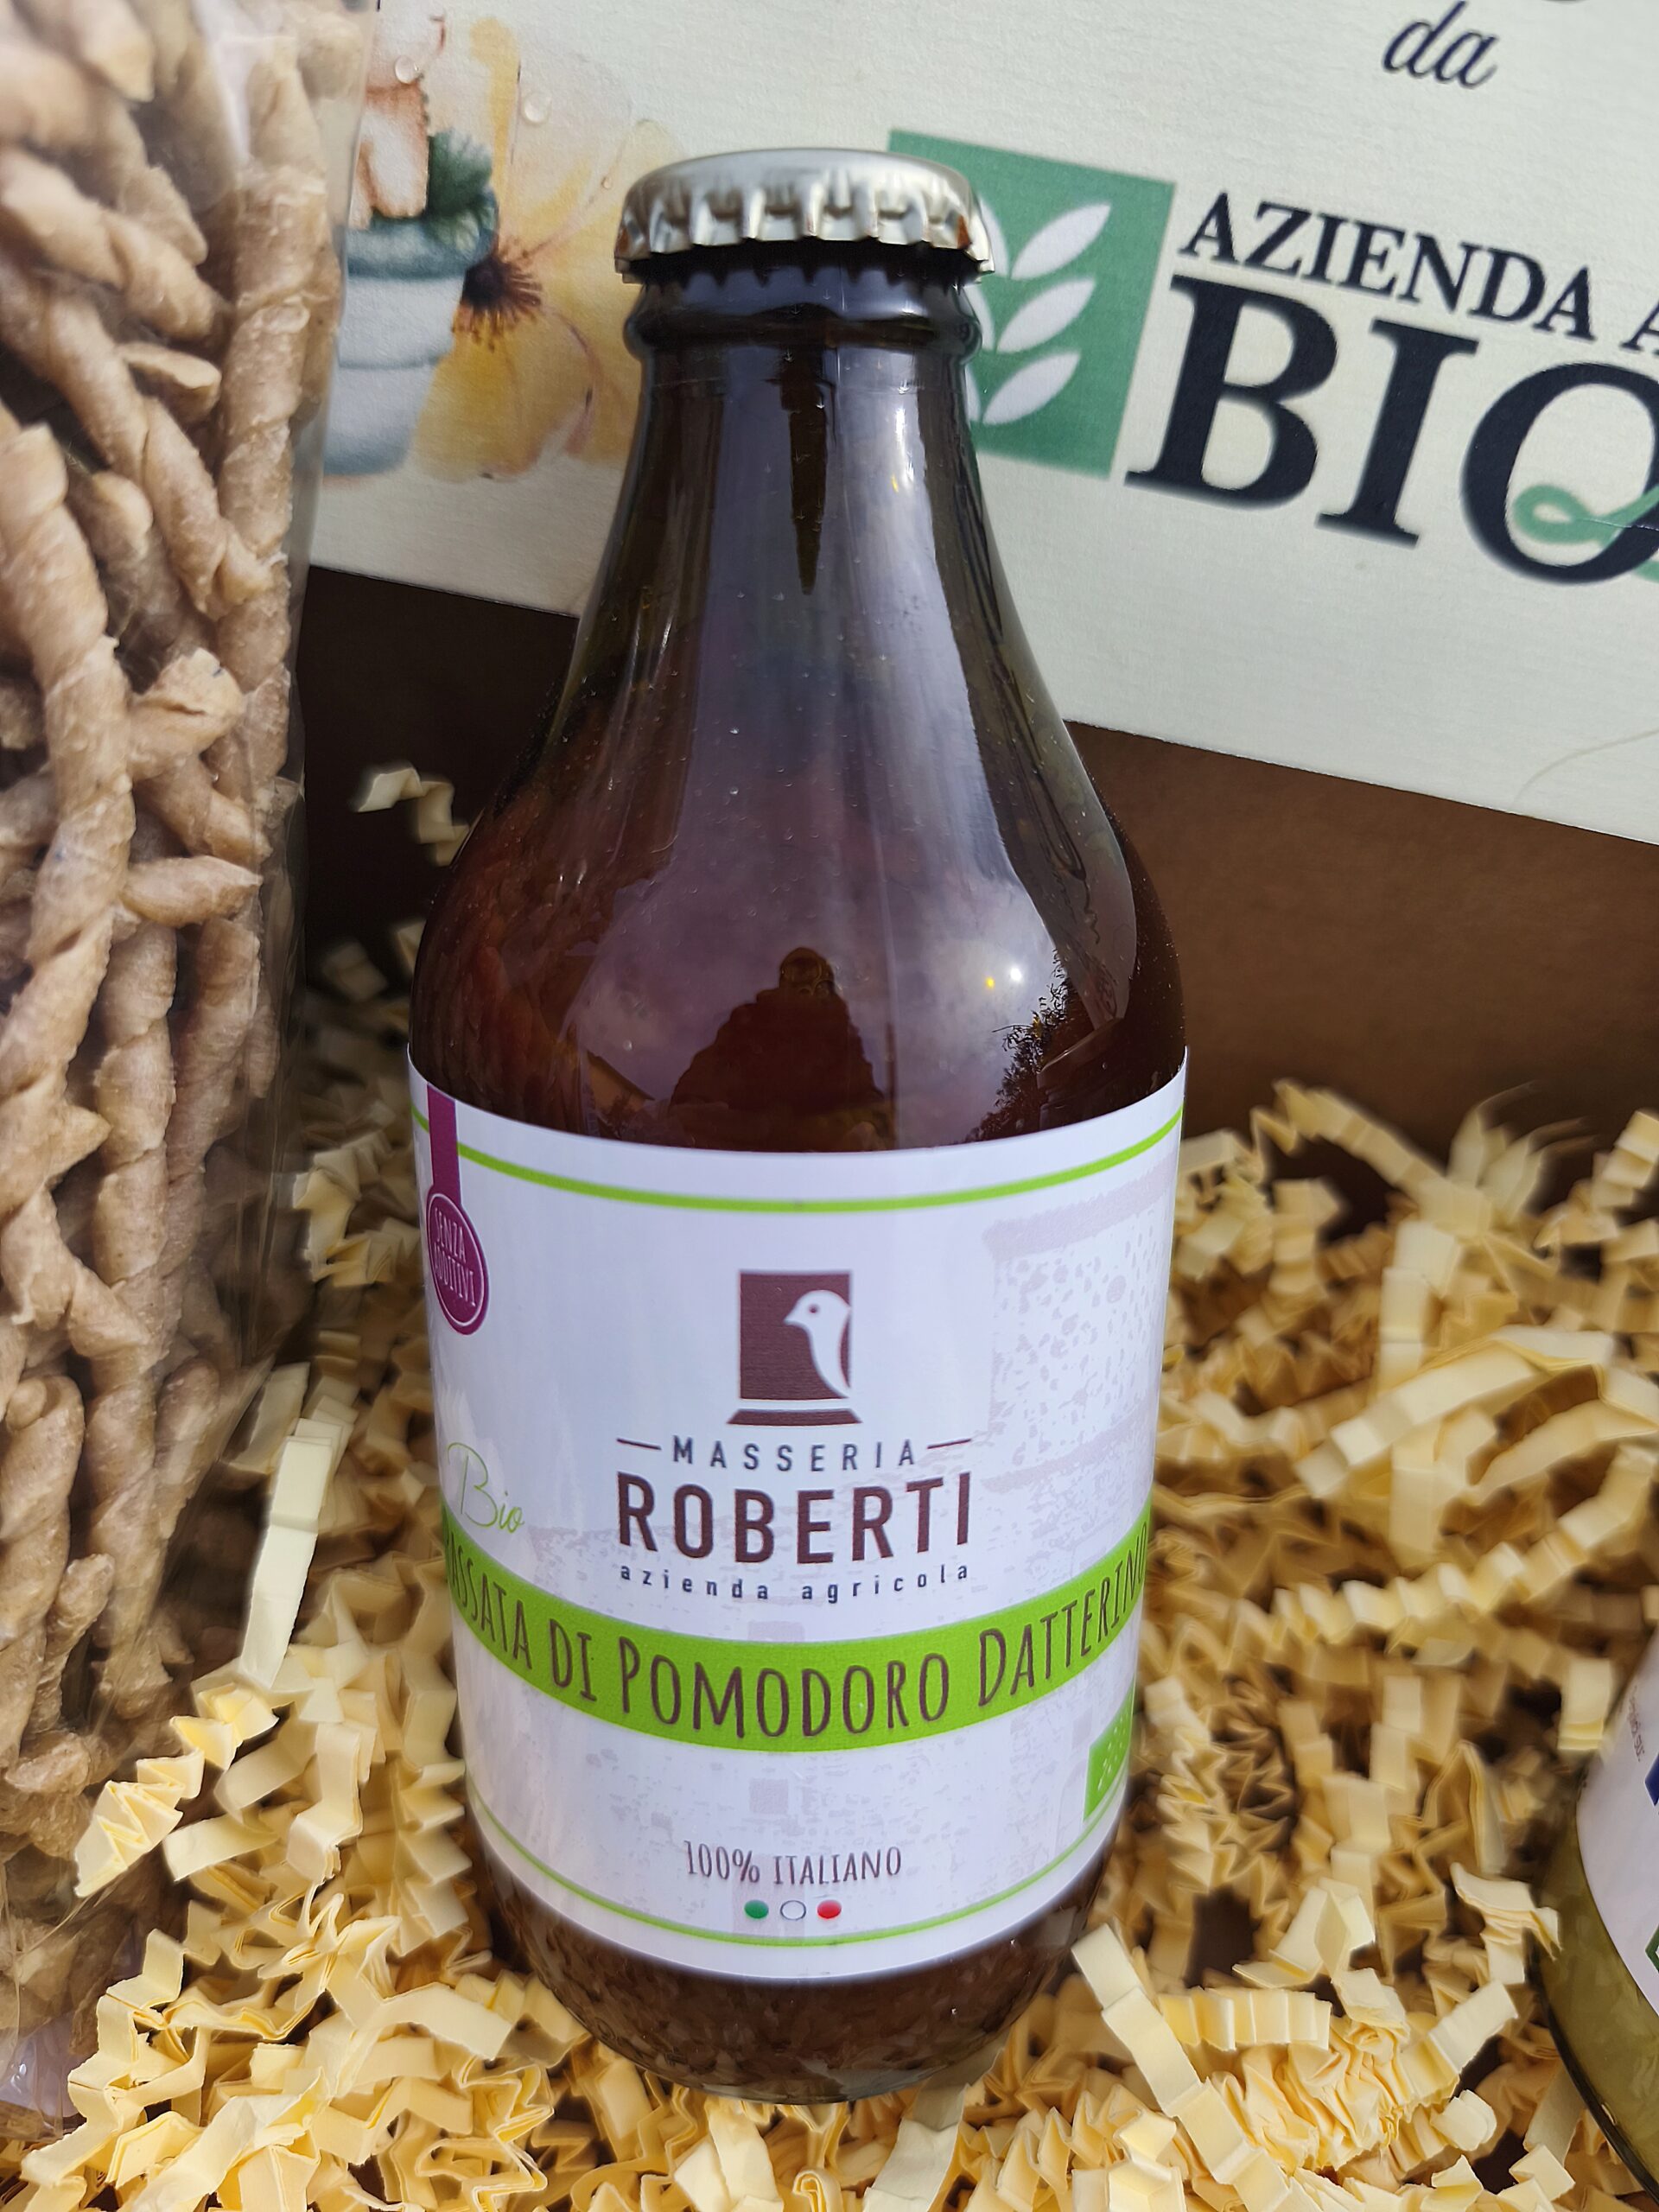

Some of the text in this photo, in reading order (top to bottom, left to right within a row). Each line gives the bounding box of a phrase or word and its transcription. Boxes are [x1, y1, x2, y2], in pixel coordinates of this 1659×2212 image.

[1382, 0, 1497, 87] da
[1178, 191, 1596, 341] AZIENDA
[435, 1207, 467, 1264] SENZA
[447, 1441, 525, 1534] Bio
[672, 1435, 916, 1471] MASSERIA
[617, 1471, 972, 1565] ROBERTI
[620, 1564, 969, 1604] azienda agricola
[550, 1618, 597, 1702] DI
[618, 1636, 950, 1738] POMODORO
[683, 1840, 901, 1885] 100% ITALIANO
